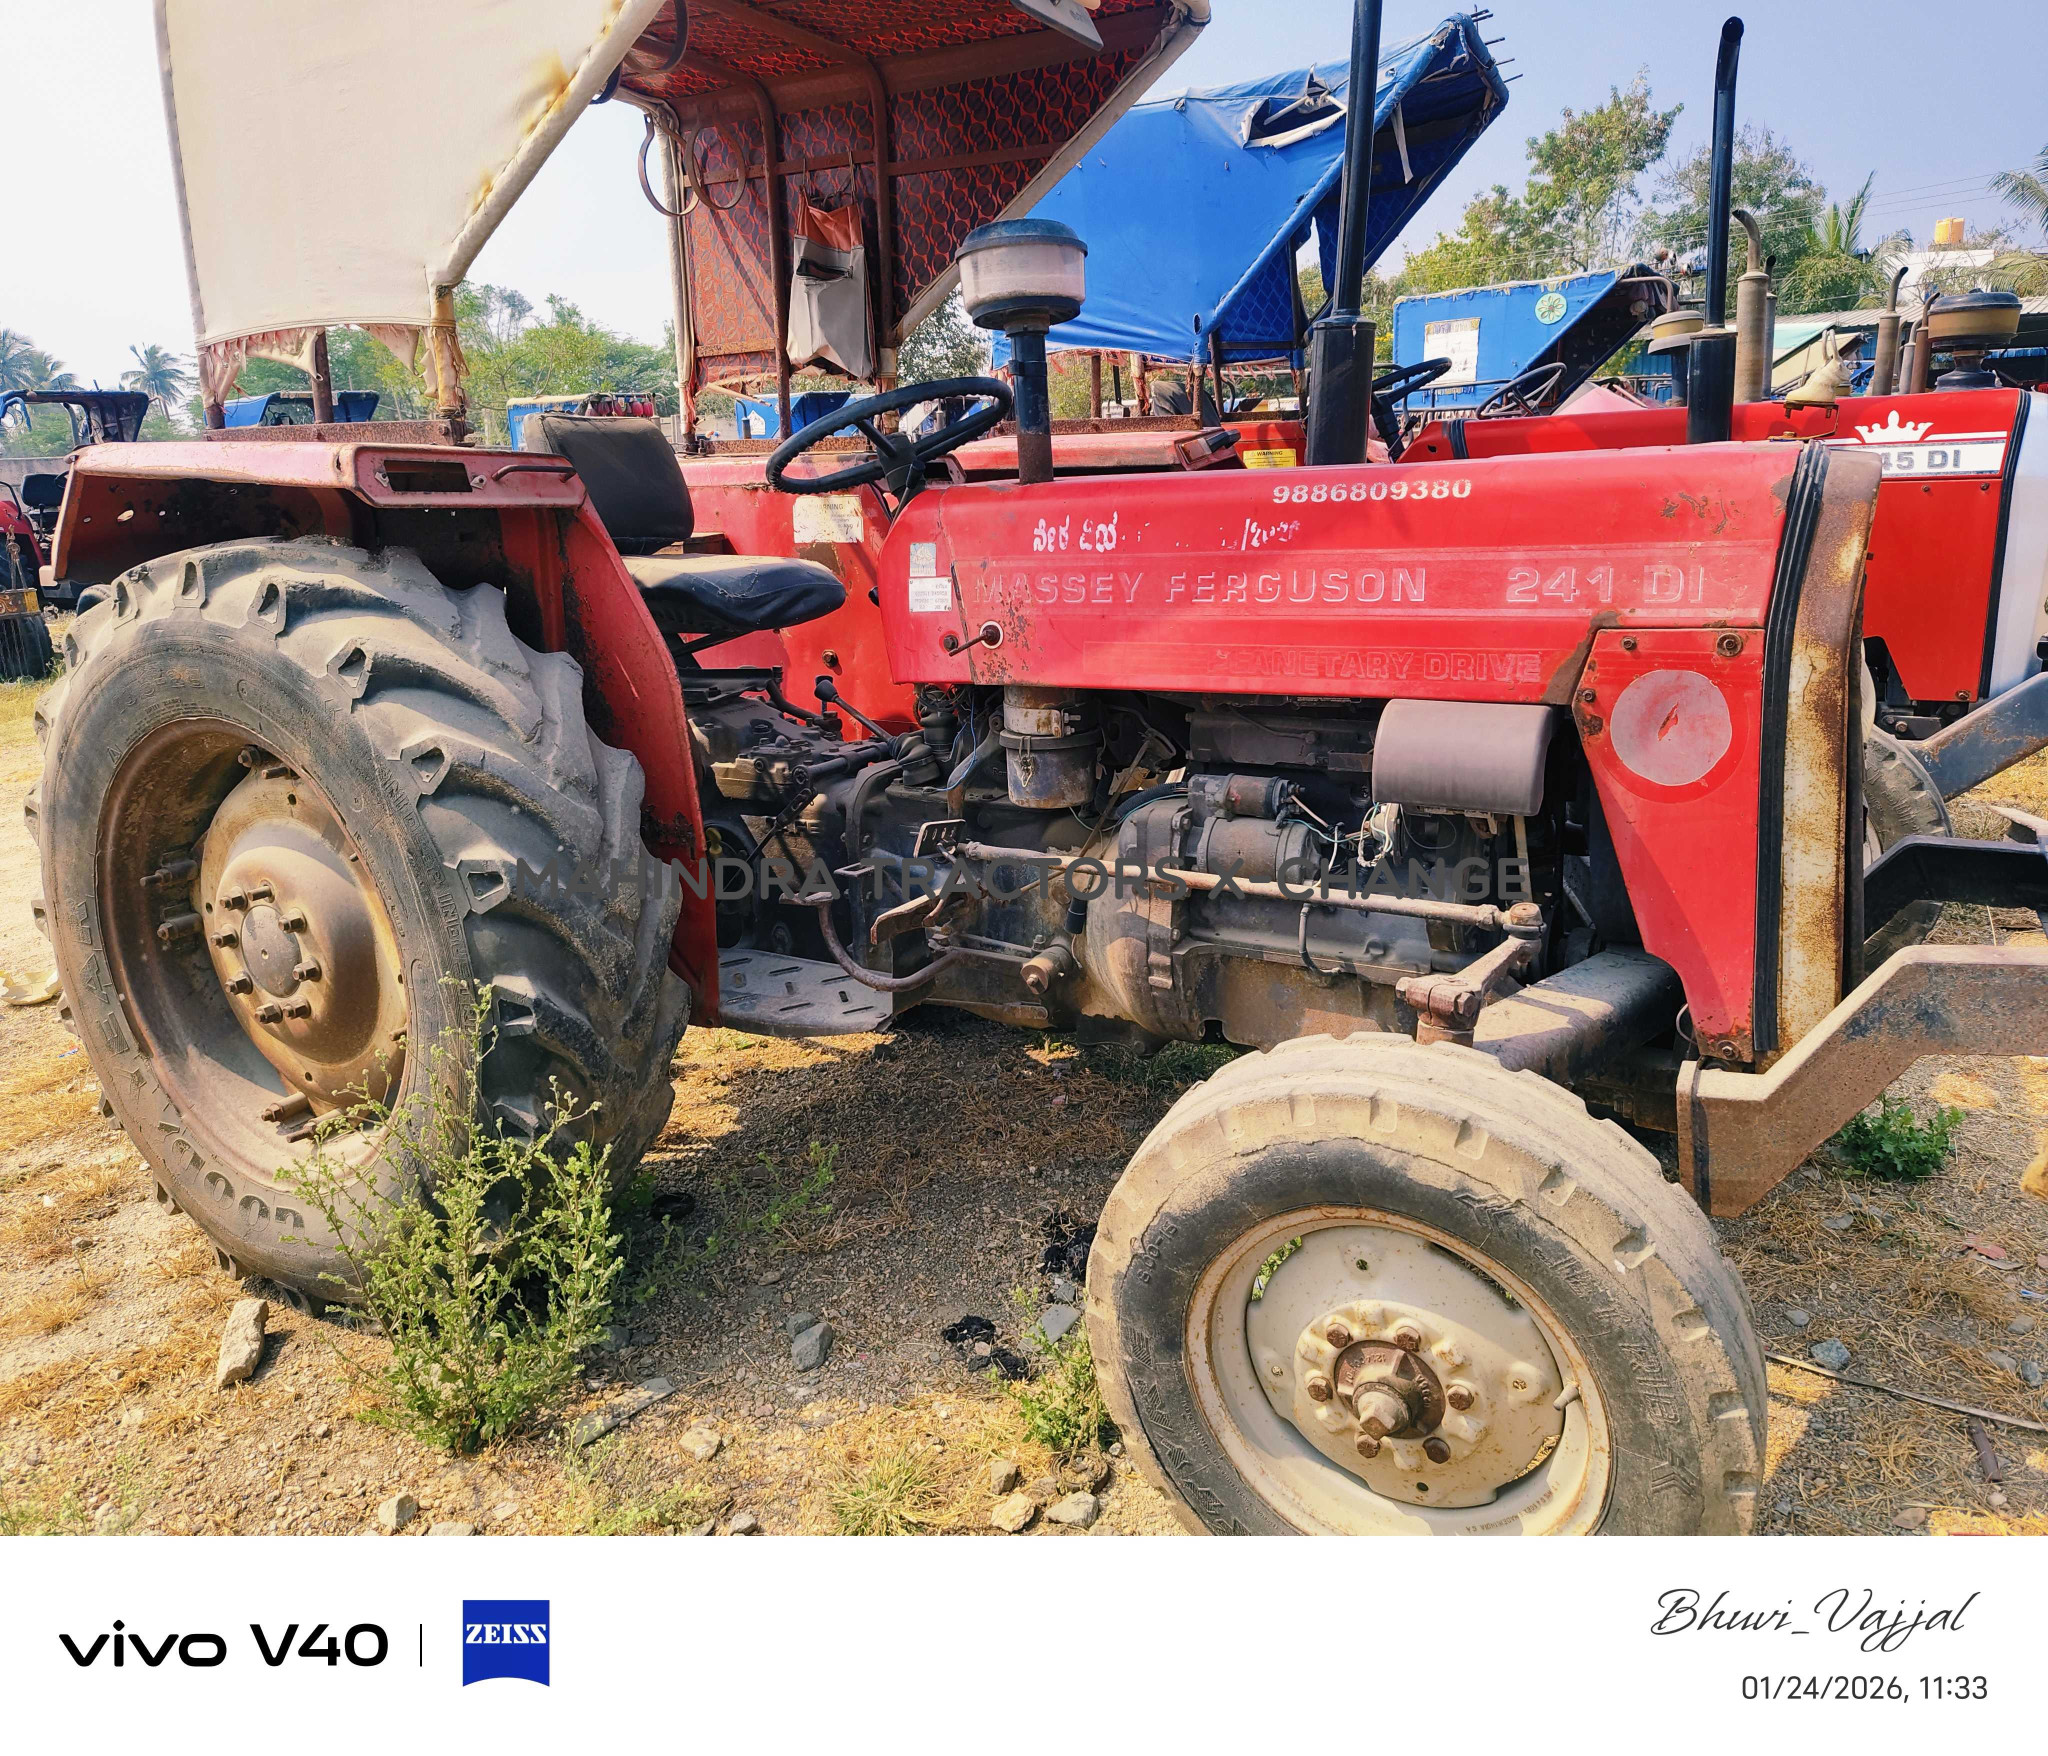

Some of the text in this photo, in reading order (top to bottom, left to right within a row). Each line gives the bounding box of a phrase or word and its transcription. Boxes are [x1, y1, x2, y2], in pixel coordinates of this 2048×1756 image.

[1927, 449, 1961, 469] DI
[1272, 479, 1472, 504] 9886809380
[973, 571, 1145, 604] MASSEY
[1165, 567, 1427, 604] FERGUSON
[1505, 564, 1615, 604] 241
[1643, 564, 1705, 604] DI
[1423, 652, 1543, 684] DRIVE
